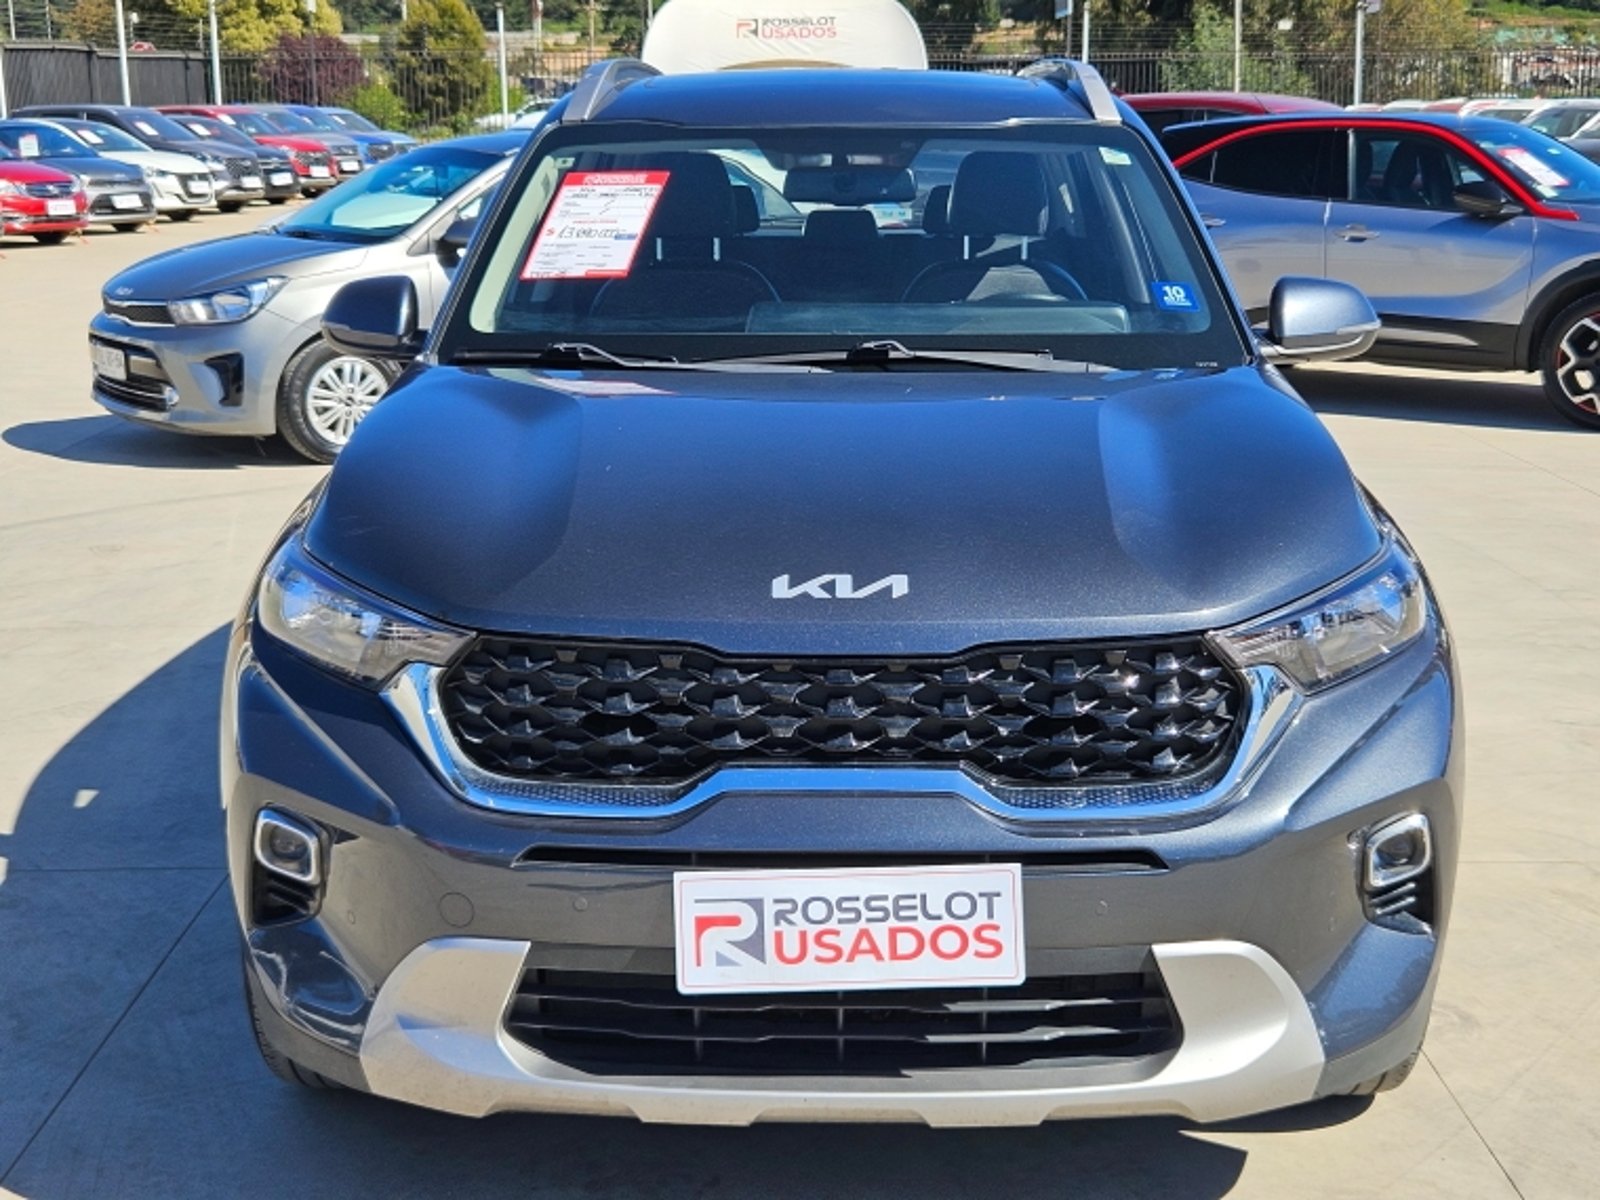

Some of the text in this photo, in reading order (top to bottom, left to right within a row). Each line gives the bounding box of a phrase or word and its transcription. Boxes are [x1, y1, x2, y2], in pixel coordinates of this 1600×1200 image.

[761, 27, 837, 39] USADOS
[771, 573, 909, 599] KIA
[772, 891, 1002, 927] ROSSELOT
[773, 923, 1004, 966] USADOS
